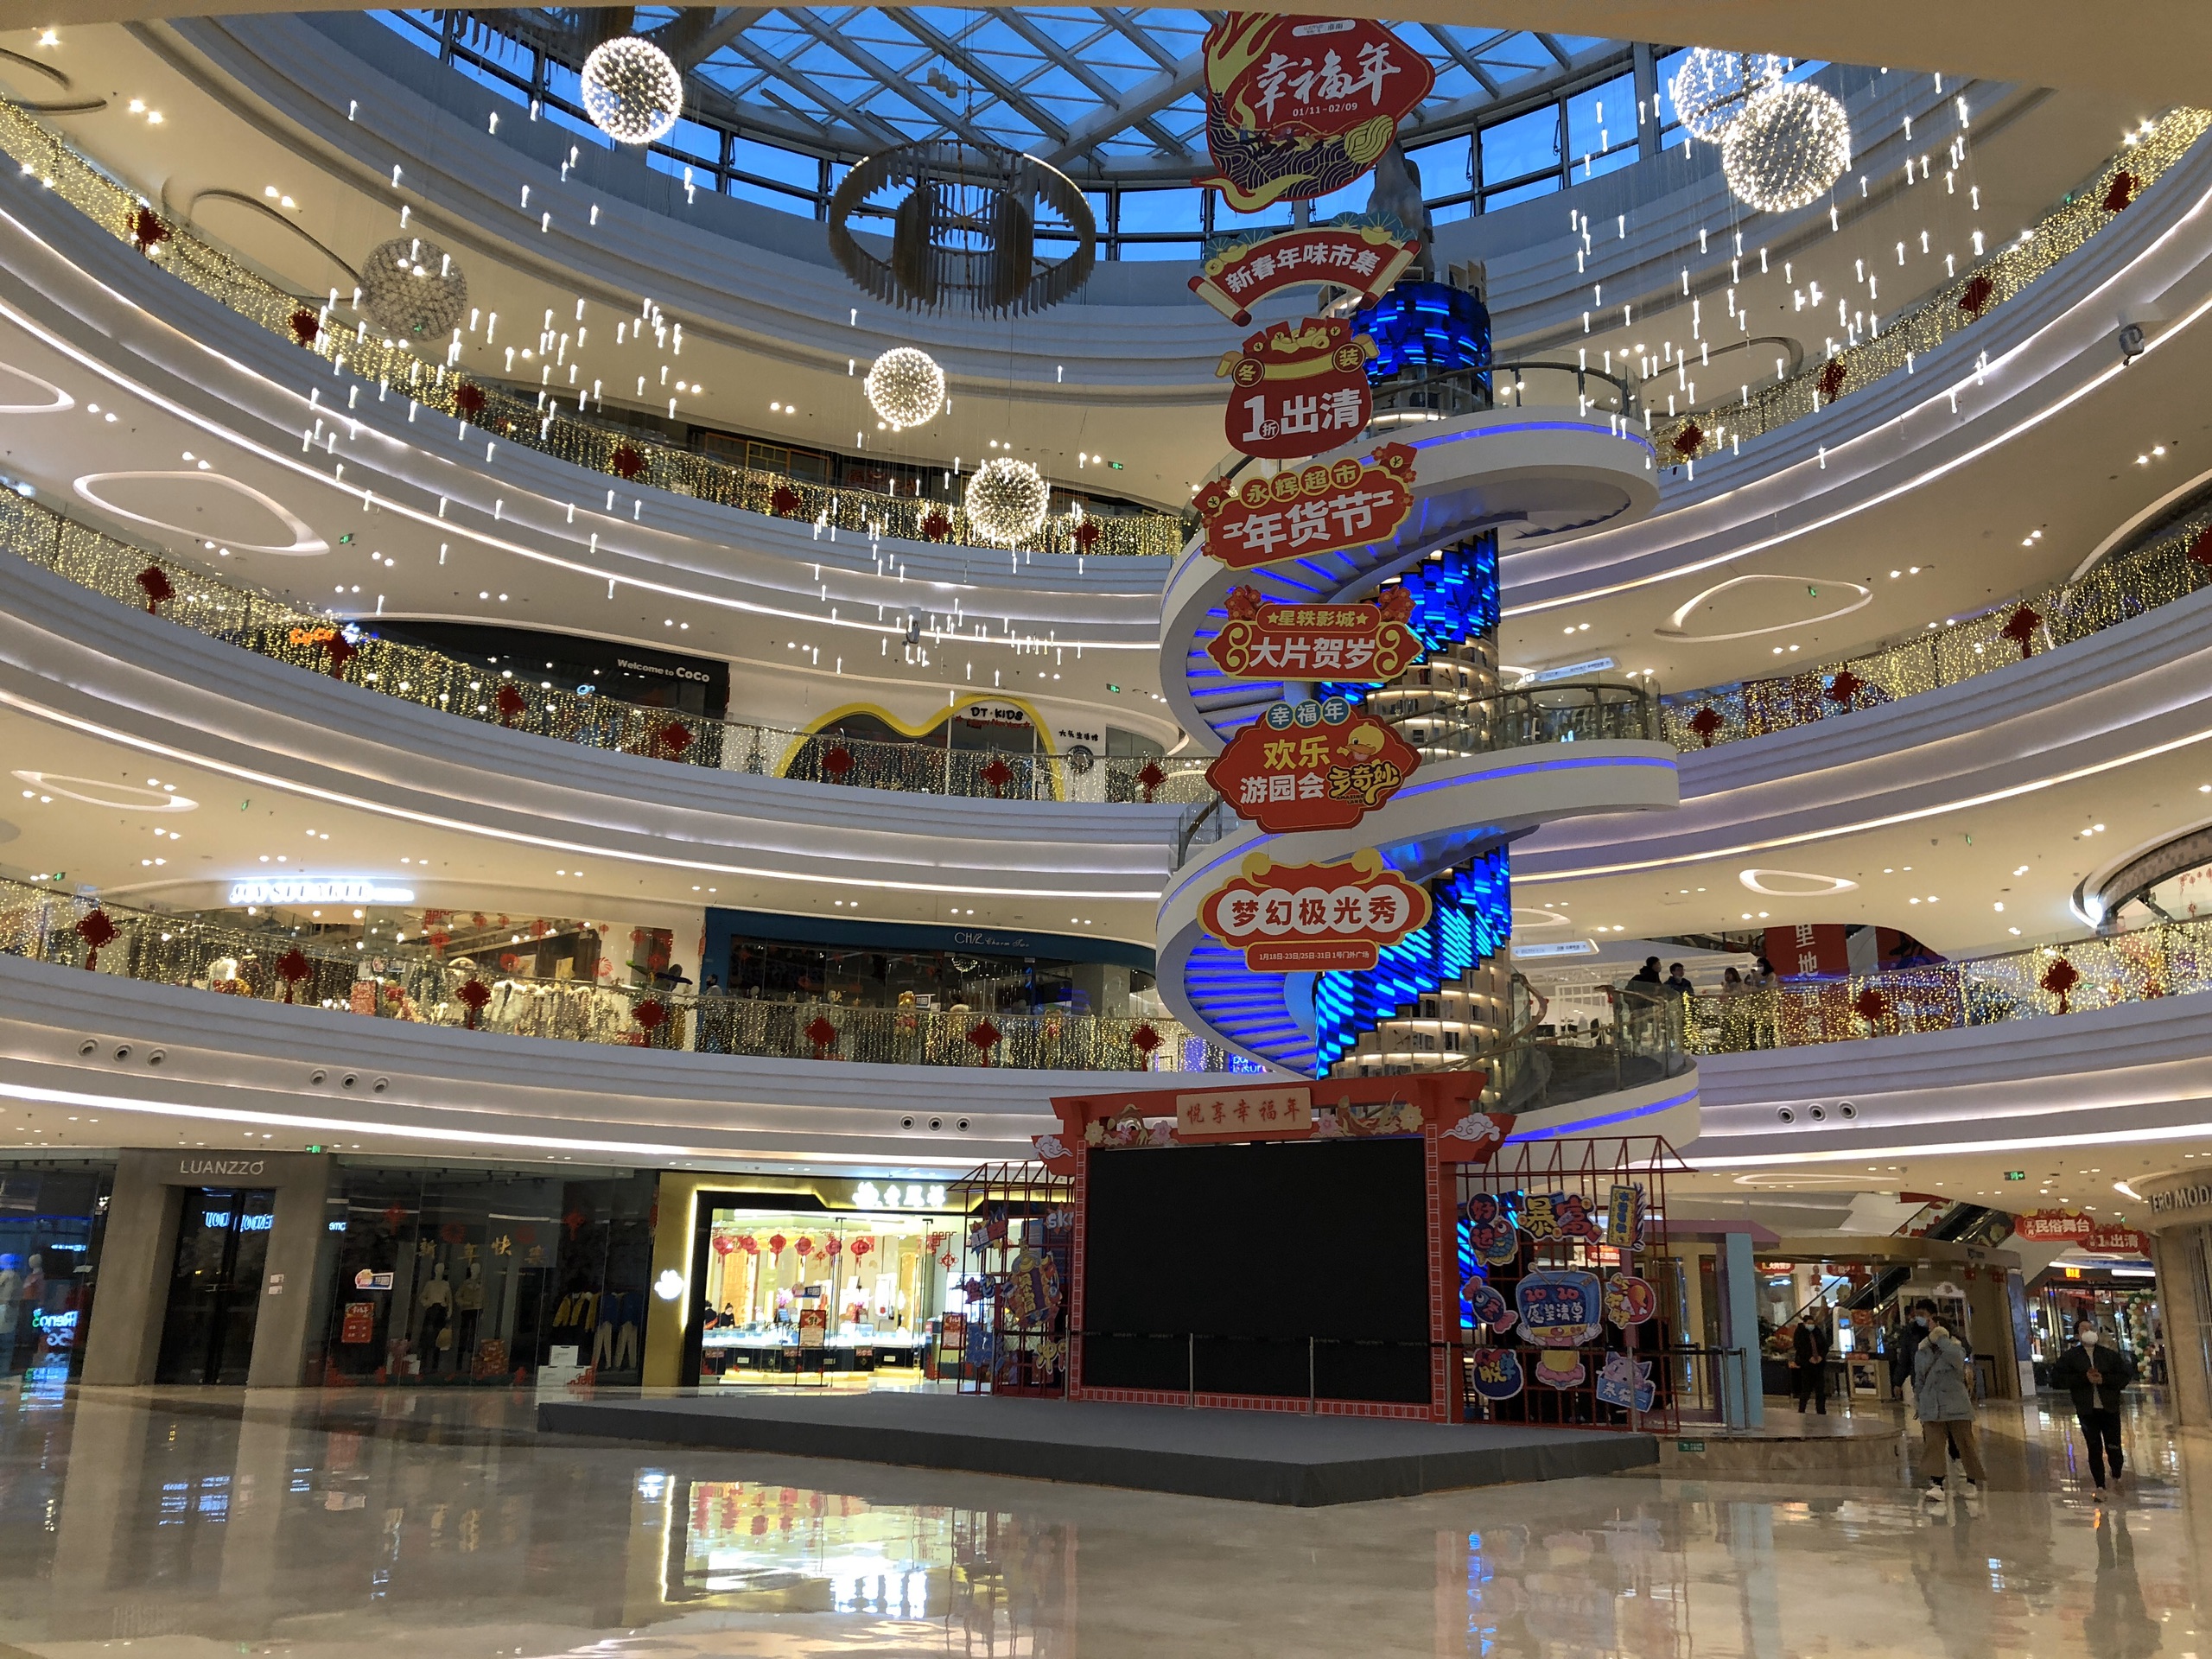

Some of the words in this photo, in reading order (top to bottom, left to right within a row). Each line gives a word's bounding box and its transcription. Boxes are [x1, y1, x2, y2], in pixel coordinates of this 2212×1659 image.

[1255, 42, 1401, 122] 幸福年
[1225, 242, 1381, 294] 新春年味市集
[1246, 465, 1357, 503] 永辉超市
[1236, 492, 1376, 553] 年货节
[618, 659, 664, 674] Welcome
[1249, 636, 1376, 670] 大片贺岁
[995, 709, 1024, 721] KIDS
[1270, 702, 1344, 726] 幸福年
[1263, 735, 1331, 770] 欢乐
[1240, 772, 1325, 804] 游园会
[1232, 896, 1397, 929] 梦幻极光秀
[1186, 1097, 1300, 1123] 悦享幸福年
[2175, 1185, 2212, 1208] MOD
[2036, 1219, 2089, 1233] 民俗舞台
[1528, 1302, 1583, 1324] 愿望清单
